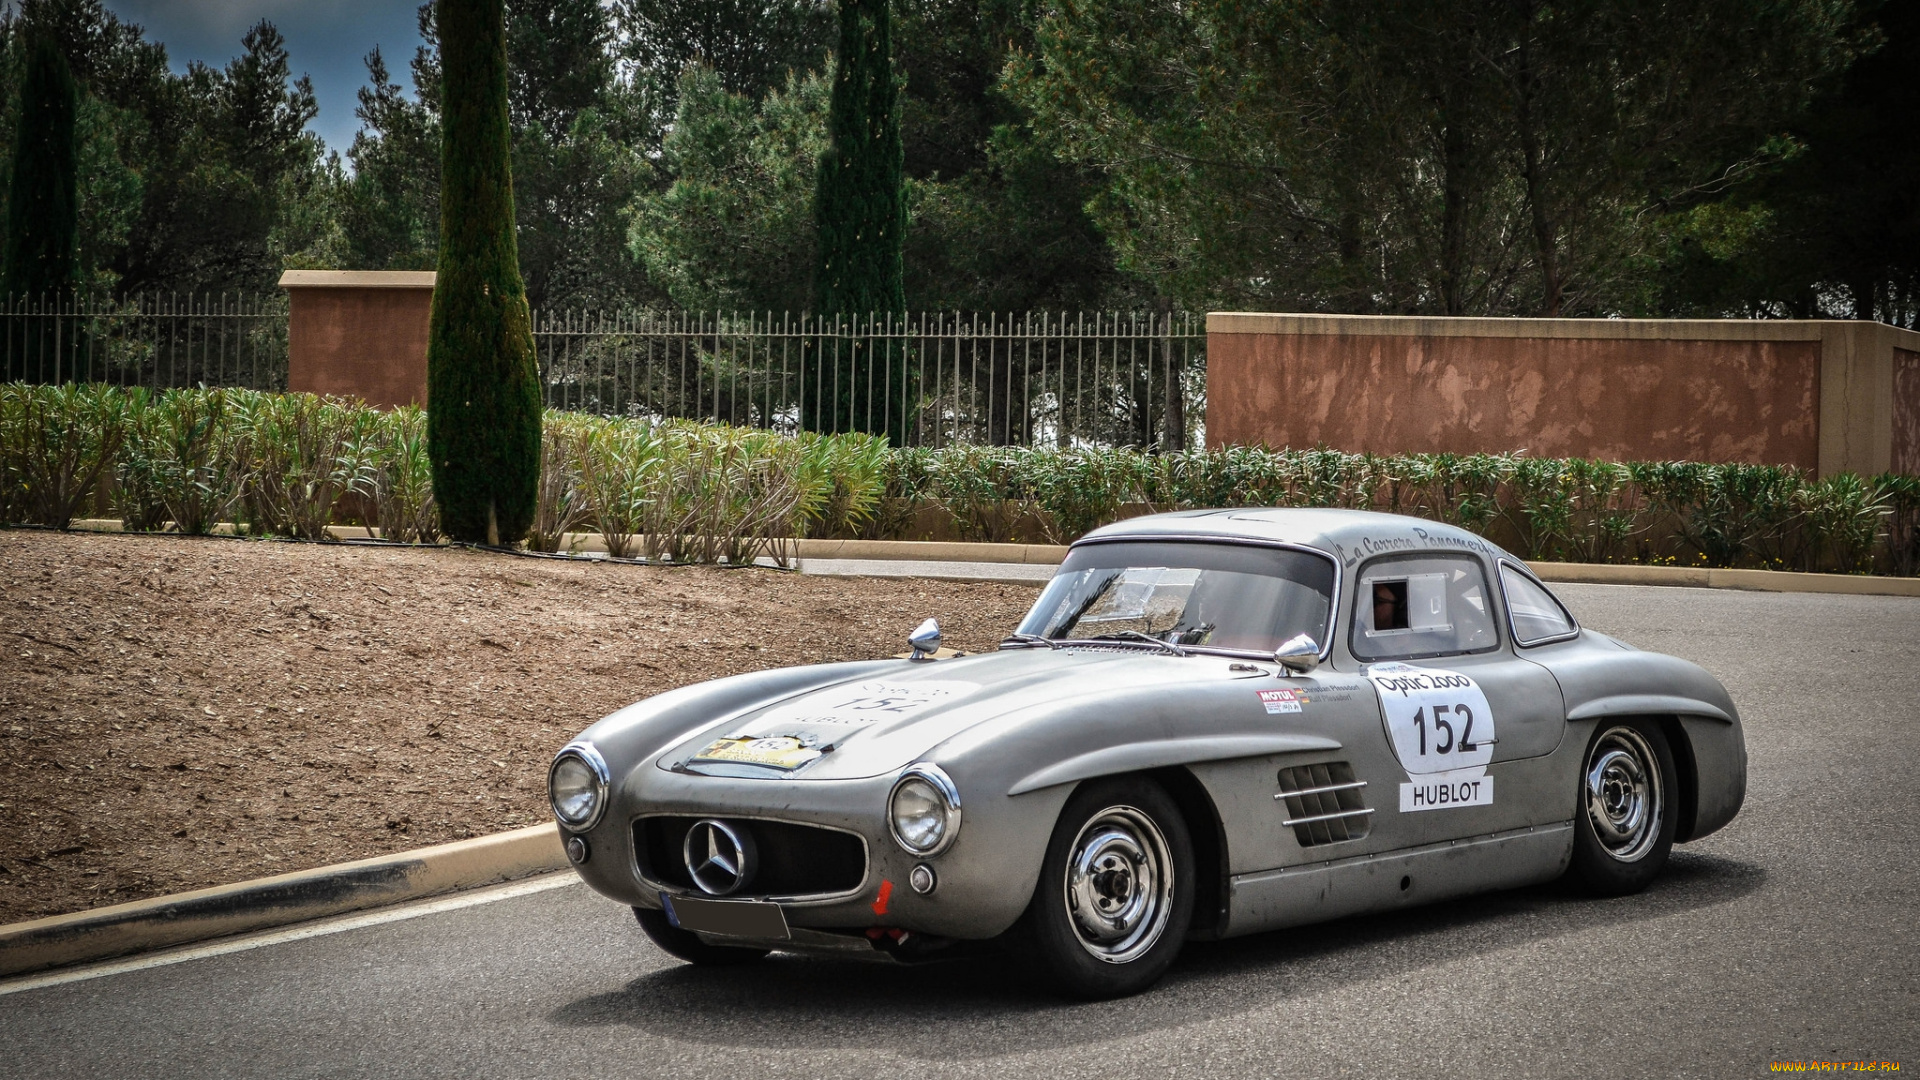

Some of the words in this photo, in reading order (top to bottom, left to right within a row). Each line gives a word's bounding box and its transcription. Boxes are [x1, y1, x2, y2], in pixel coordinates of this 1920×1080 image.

[1336, 543, 1363, 568] La
[1363, 537, 1415, 554] Carrera
[1260, 691, 1295, 700] MOTUL
[1375, 675, 1429, 697] Optic
[1420, 674, 1470, 689] 2000
[833, 697, 928, 713] 152
[1413, 703, 1478, 755] 152
[752, 739, 789, 750] 152
[1413, 781, 1481, 806] HUBLOT
